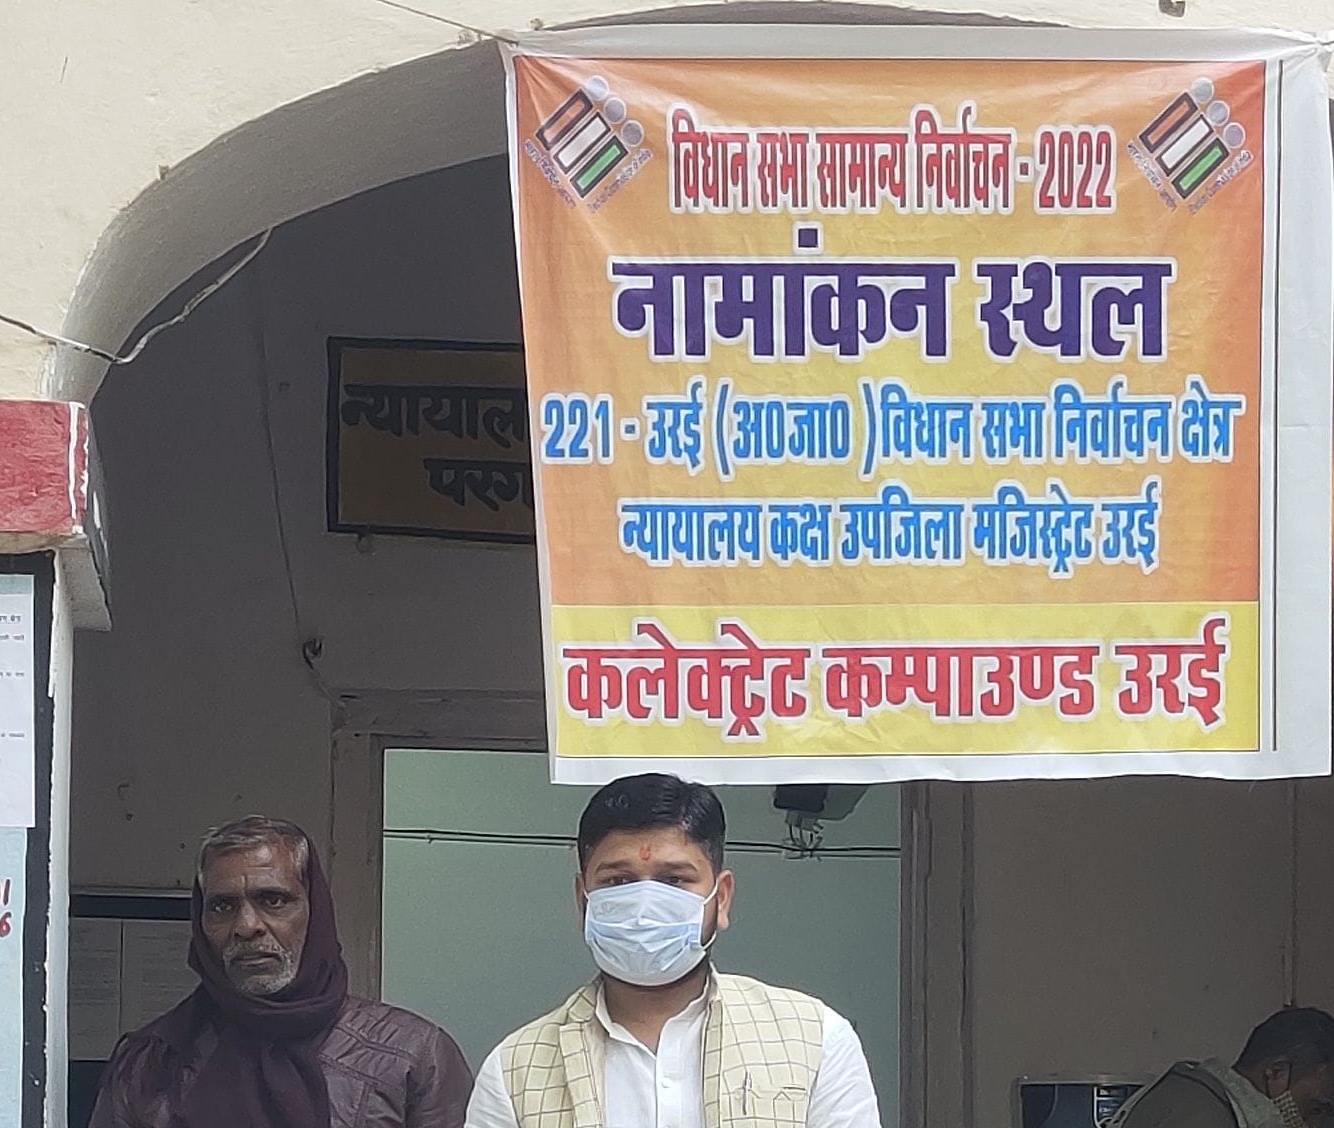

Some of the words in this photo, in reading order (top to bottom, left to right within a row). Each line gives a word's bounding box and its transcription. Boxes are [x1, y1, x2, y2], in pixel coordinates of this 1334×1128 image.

[671, 107, 750, 209] विधान
[756, 131, 810, 209] सभा
[815, 132, 909, 209] सामान्य
[914, 105, 1012, 209] निर्वाचन
[1038, 130, 1112, 209] 2022
[611, 227, 957, 357] नामांकन
[976, 260, 1173, 357] स्थल
[340, 383, 529, 449] न्यायाल
[543, 399, 611, 458] 221
[645, 380, 704, 469] उरई
[980, 399, 1046, 458] सभा
[1052, 380, 1173, 458] निर्वाचन
[1180, 380, 1242, 457] क्षेत्र
[422, 457, 535, 512] परग
[621, 503, 763, 561] न्यायालय
[767, 502, 832, 561] कक्ष
[839, 484, 965, 560] उपजिला
[971, 482, 1095, 573] मजिस्ट्रेट
[1100, 480, 1158, 568] उरई
[561, 622, 812, 737] कलेक्ट्रेट
[821, 645, 1100, 718] कम्पाउण्ड
[1114, 617, 1226, 727] उरई
